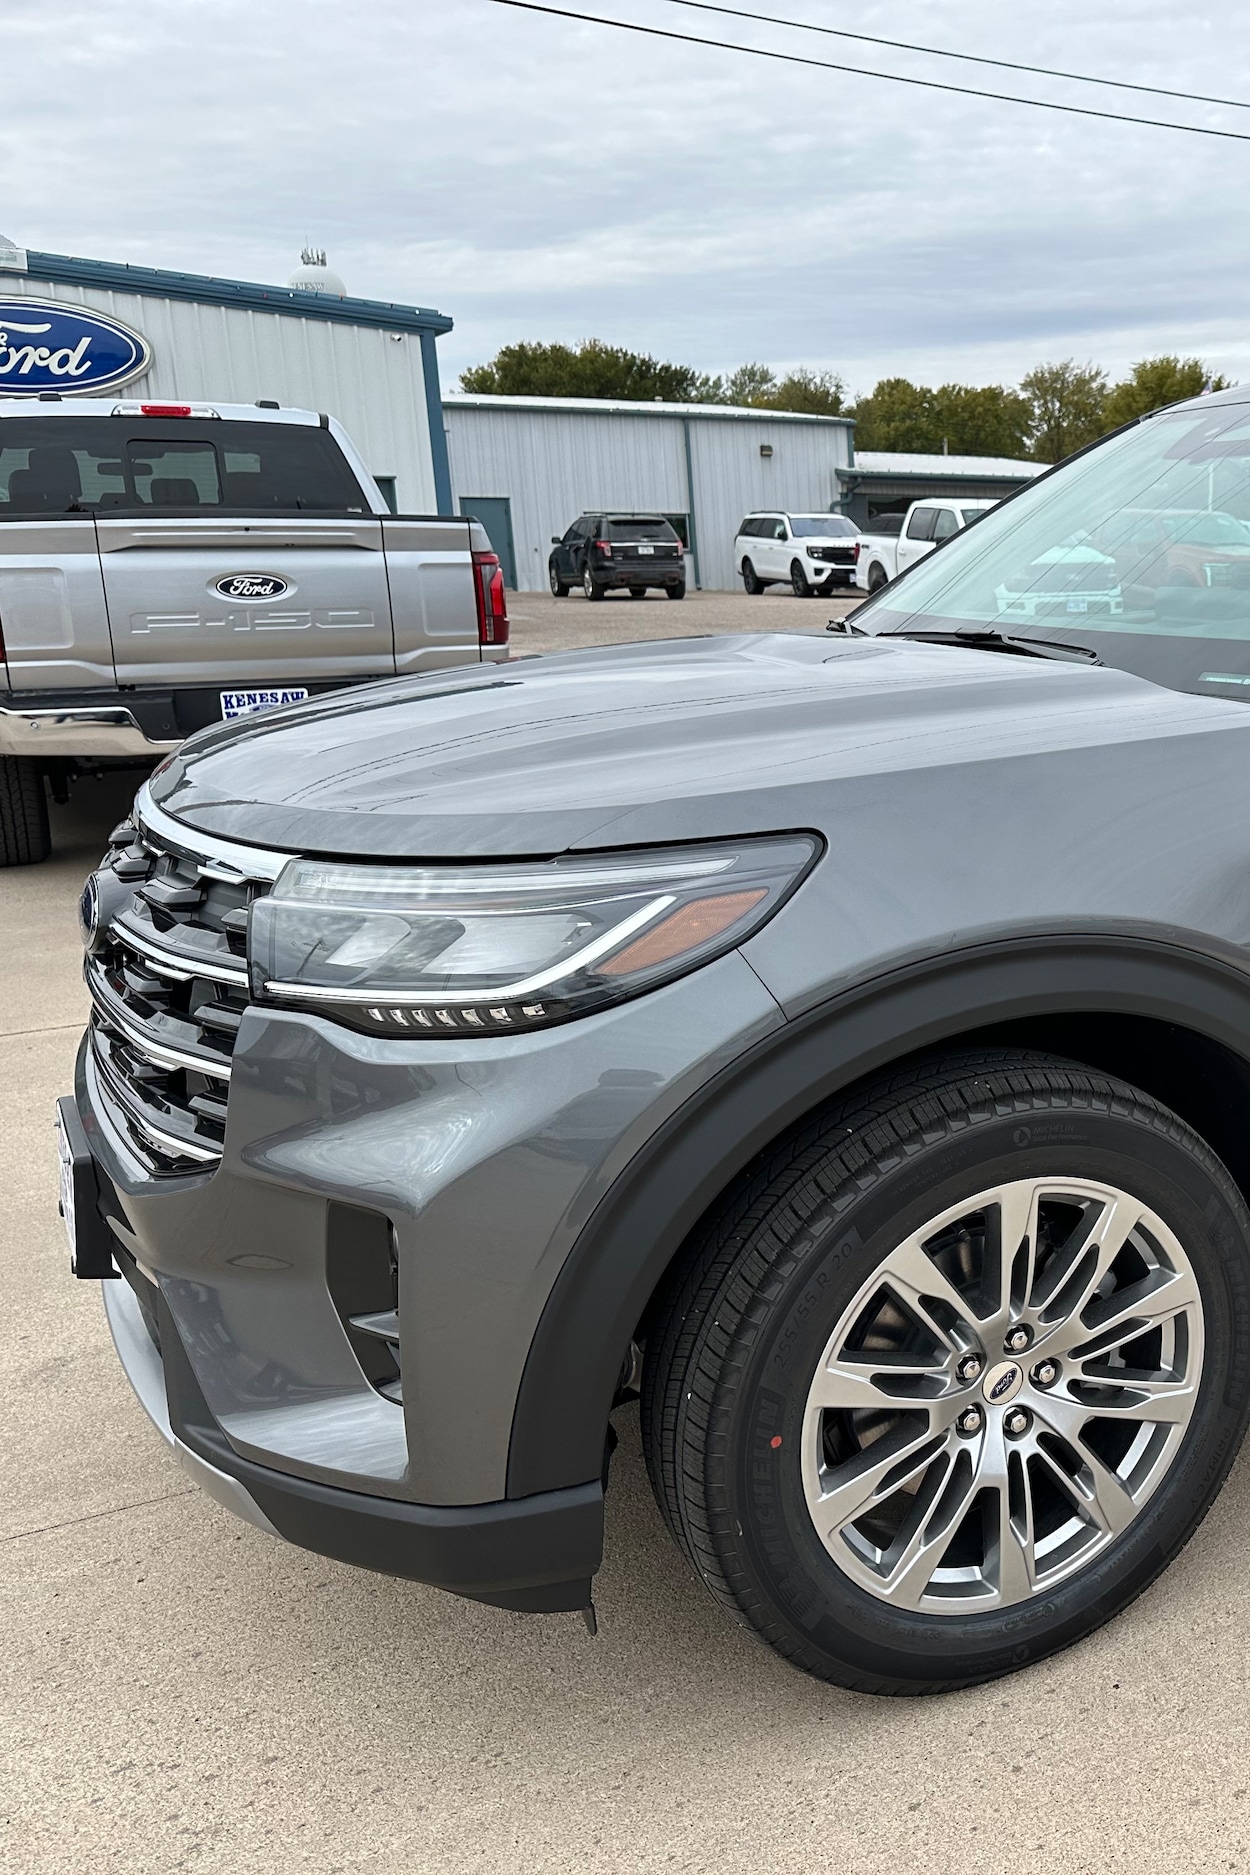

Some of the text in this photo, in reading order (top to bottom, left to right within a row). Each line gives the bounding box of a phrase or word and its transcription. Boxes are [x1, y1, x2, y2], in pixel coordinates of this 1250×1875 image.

[229, 577, 274, 596] Ford
[129, 607, 375, 634] F-150
[223, 691, 305, 710] KENESAW
[774, 1291, 818, 1369] 255/55
[816, 1272, 831, 1290] R
[832, 1242, 853, 1271] 20
[752, 1395, 790, 1567] MICHELIN
